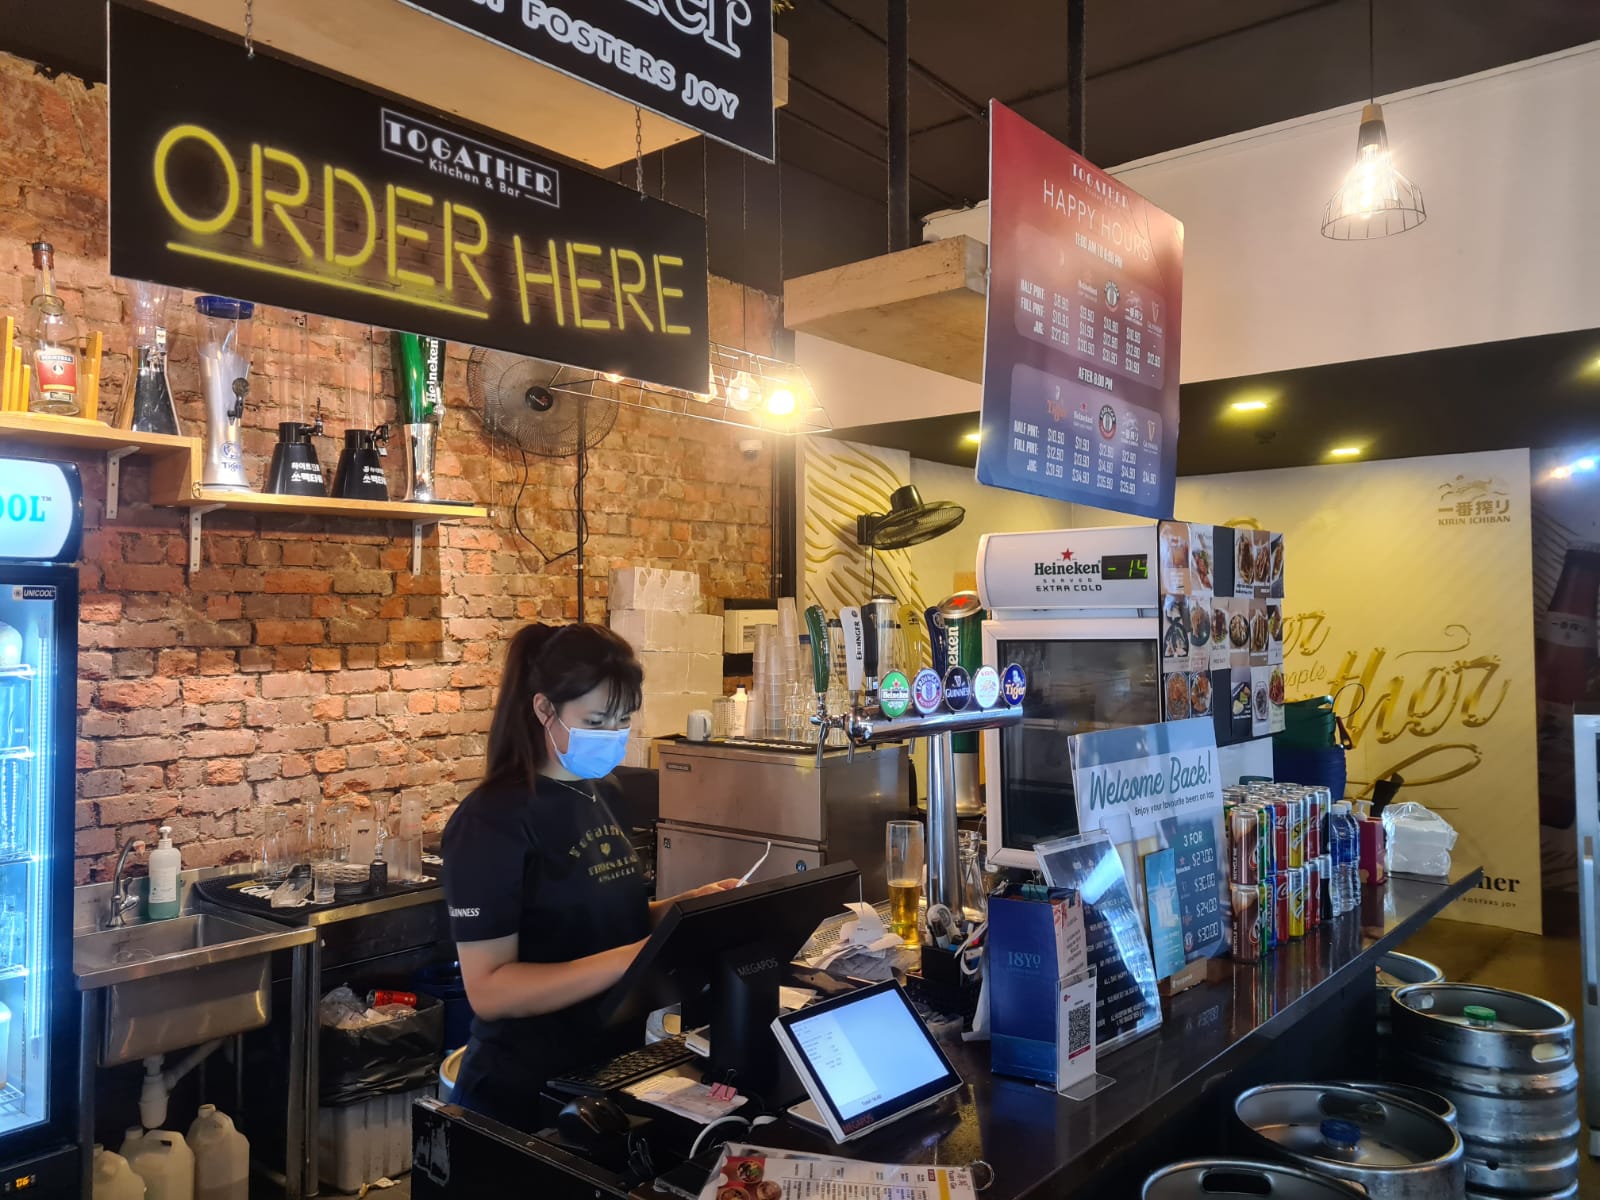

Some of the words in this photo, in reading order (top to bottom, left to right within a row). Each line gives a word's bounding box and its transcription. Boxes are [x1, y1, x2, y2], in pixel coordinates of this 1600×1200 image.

[521, 0, 676, 91] FOSTERS
[681, 73, 740, 119] JOY
[386, 119, 552, 196] TOGATHER
[429, 157, 479, 185] Kitchen
[484, 176, 494, 190] &
[499, 181, 521, 198] Bar
[152, 124, 494, 301] ORDER
[512, 235, 692, 335] HERE
[1043, 178, 1096, 230] HAPPY
[1100, 213, 1150, 262] HOURS
[1020, 279, 1032, 295] HALF
[1020, 296, 1032, 312] FULL
[426, 338, 439, 403] Heineken
[1078, 366, 1093, 384] AFTER
[1104, 376, 1113, 391] PM
[1014, 419, 1027, 434] HALF
[1014, 437, 1026, 453] FULL
[1438, 499, 1510, 517] 一番搾り
[1438, 518, 1466, 526] KIRIN
[1469, 515, 1511, 524] ICHIBAN
[1034, 560, 1101, 577] Heineken
[23, 589, 53, 598] UNICOOL
[1035, 584, 1071, 593] EXTRA
[1073, 584, 1102, 592] COLD
[854, 621, 863, 661] ERDINGER
[1005, 680, 1026, 700] Tiger
[1090, 768, 1164, 811] Welcome
[1169, 750, 1212, 794] Back!
[1134, 806, 1149, 817] Enjoy
[1151, 803, 1163, 813] your
[1162, 798, 1185, 809] favourite
[1185, 795, 1199, 804] beers
[1206, 791, 1215, 800] tap
[1183, 835, 1188, 847] 3
[1189, 831, 1203, 845] FOR
[1192, 847, 1214, 867] $27.00
[448, 905, 480, 918] GUINNESS
[1196, 897, 1217, 918] $24.00
[1197, 921, 1219, 943] $30.00
[737, 957, 779, 977] MEGAPOS
